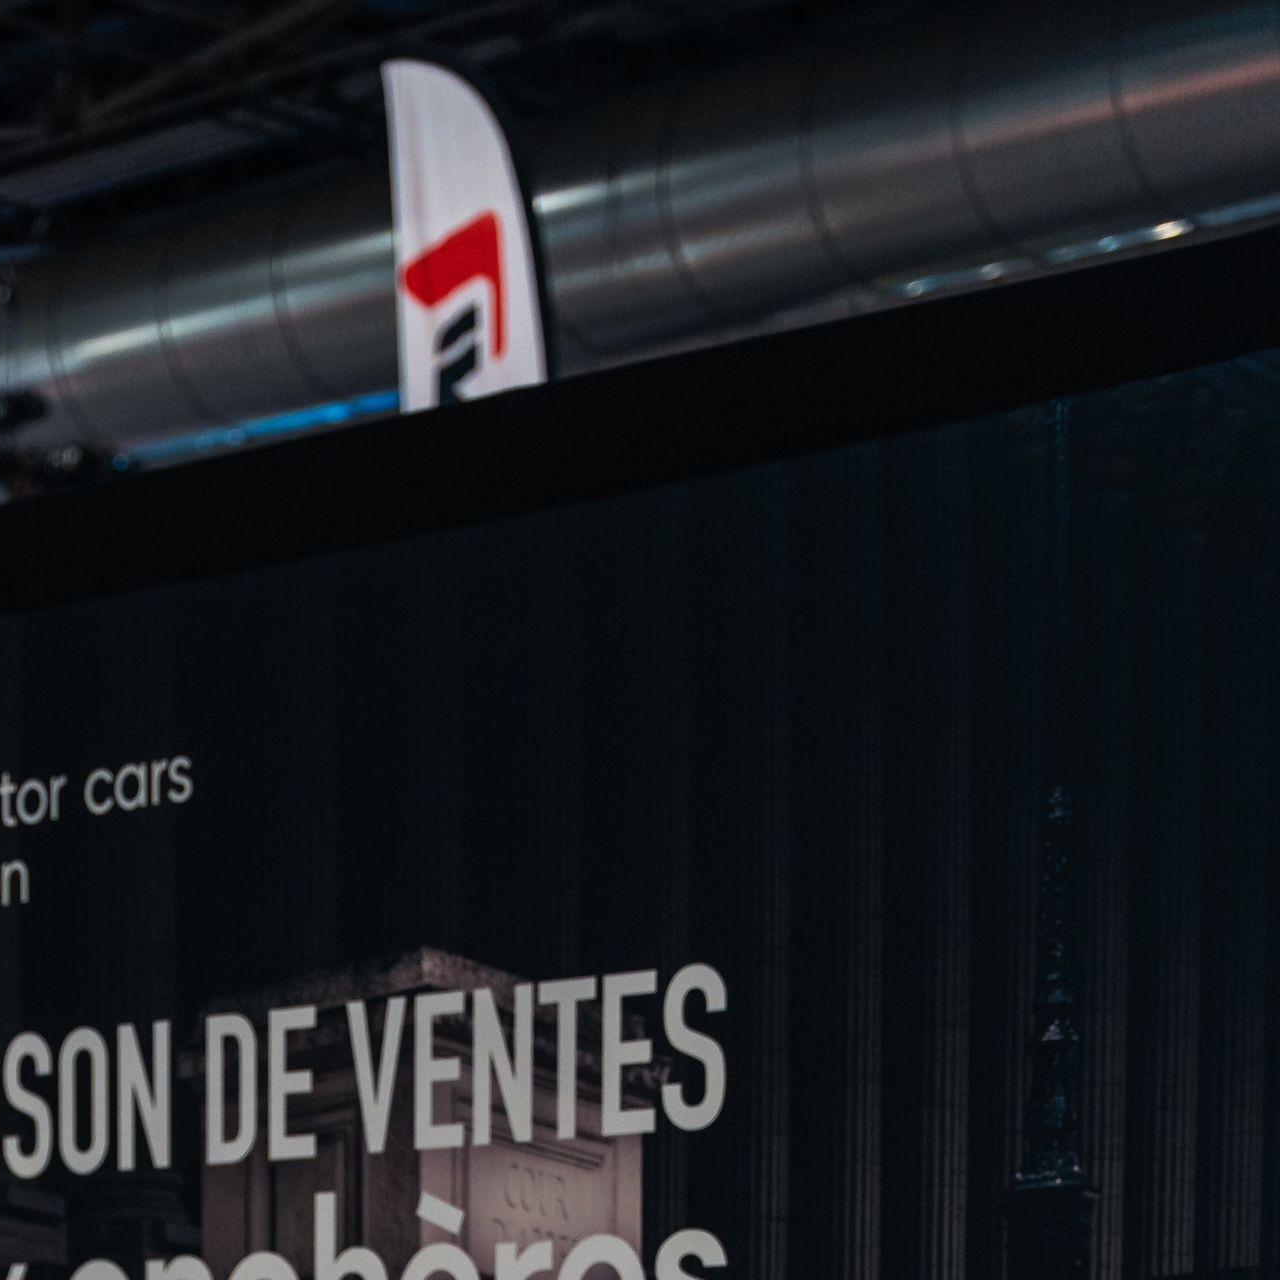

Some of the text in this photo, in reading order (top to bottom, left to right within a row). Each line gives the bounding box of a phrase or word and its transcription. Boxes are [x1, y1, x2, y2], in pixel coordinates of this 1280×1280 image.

[83, 755, 193, 816] cars
[205, 1005, 317, 1166] DE
[347, 962, 727, 1154] VENTES
